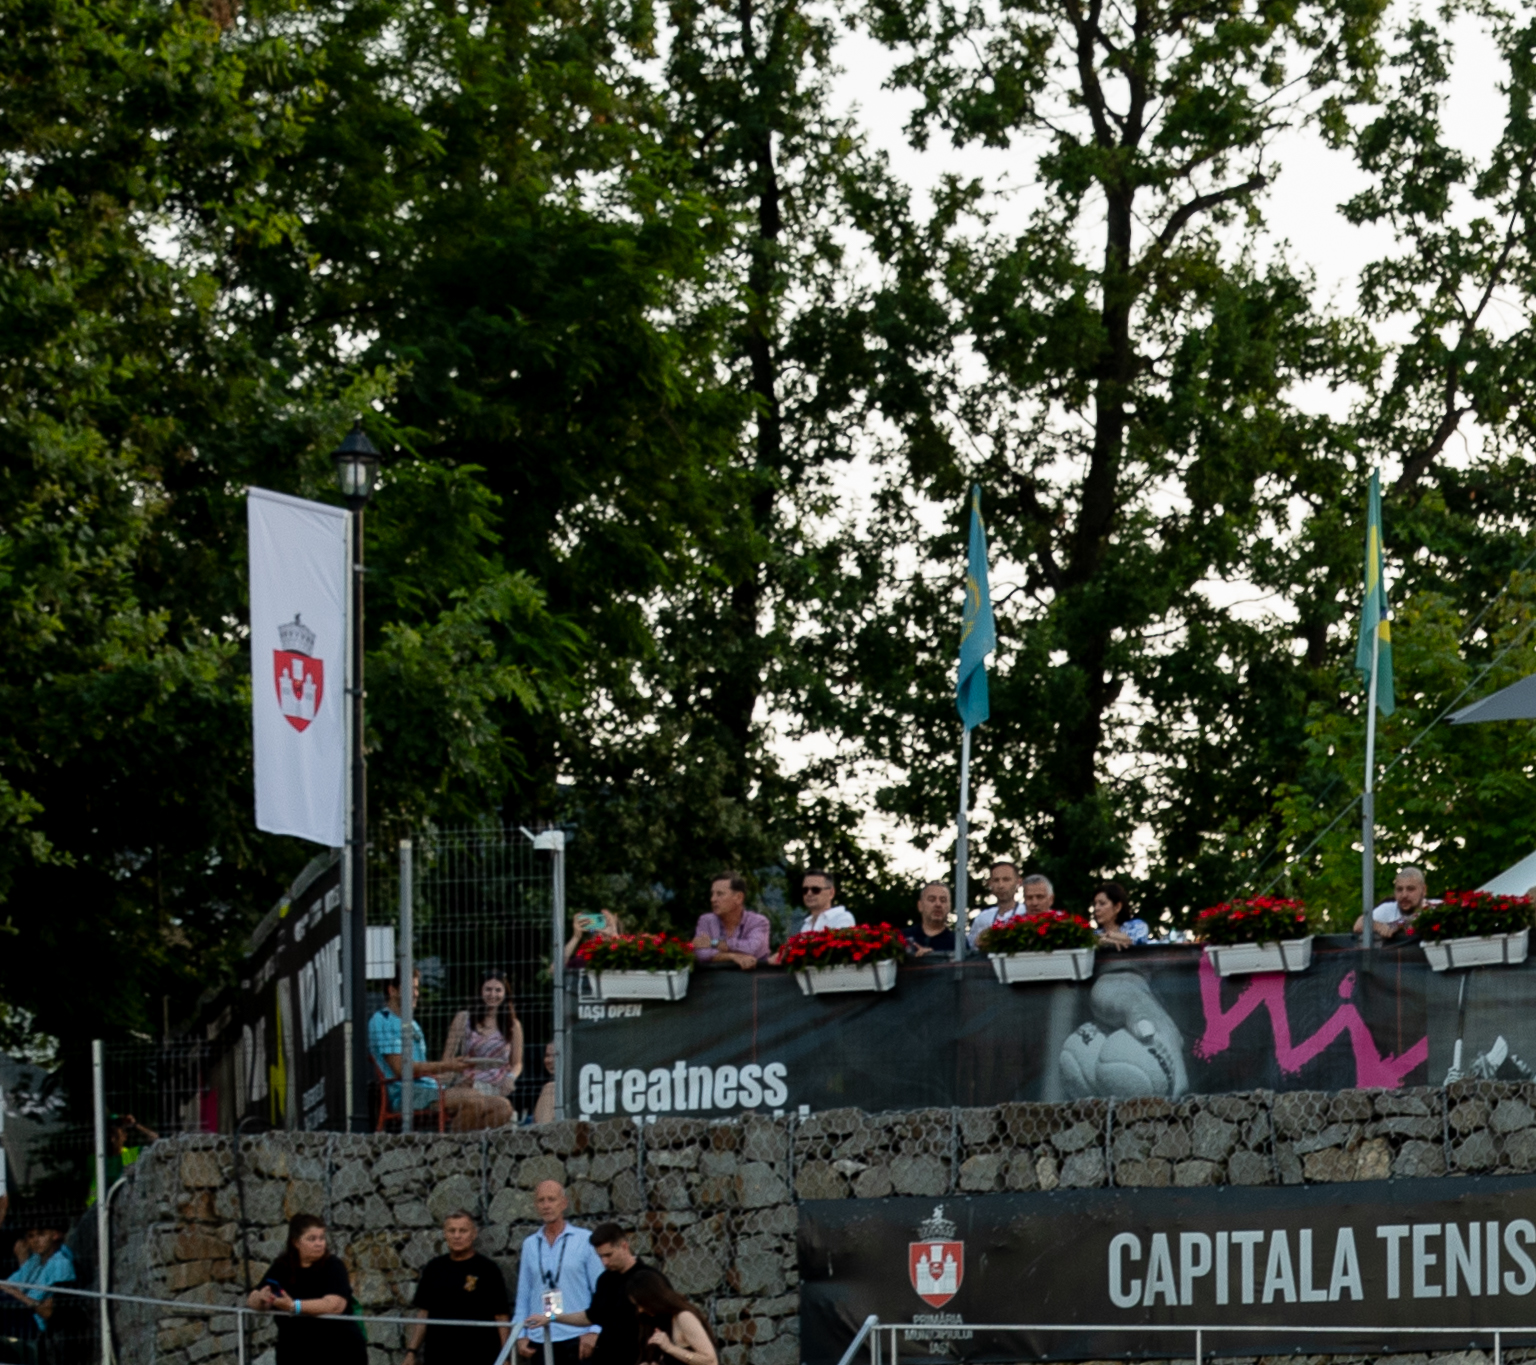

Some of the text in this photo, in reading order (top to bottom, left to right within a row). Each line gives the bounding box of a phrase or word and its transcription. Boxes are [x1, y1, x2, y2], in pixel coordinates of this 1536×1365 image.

[608, 1004, 643, 1019] OPEN
[579, 1061, 788, 1114] Greatness
[1109, 1227, 1363, 1308] CAPITALA
